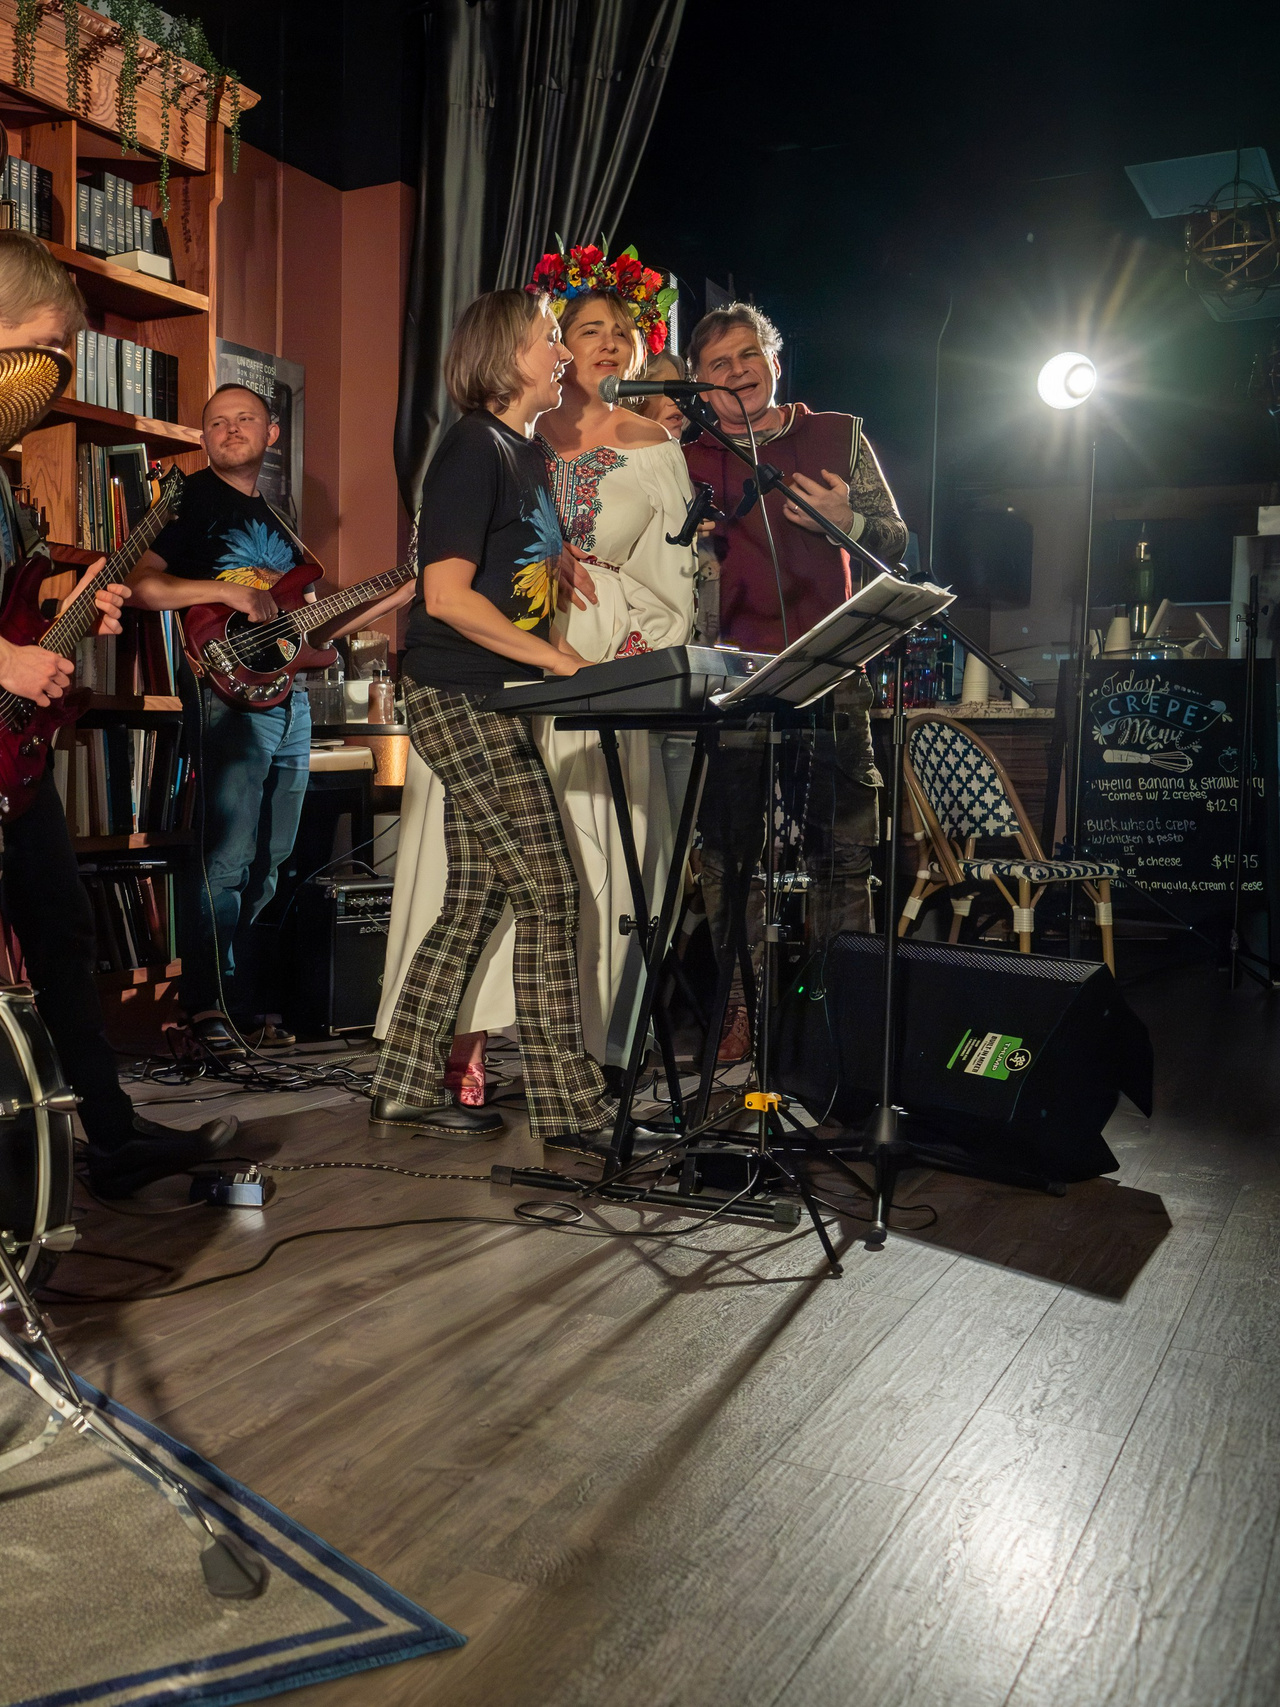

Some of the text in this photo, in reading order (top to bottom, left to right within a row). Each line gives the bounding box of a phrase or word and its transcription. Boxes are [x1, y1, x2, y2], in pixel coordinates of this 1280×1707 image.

[1101, 669, 1170, 706] Today's
[1108, 694, 1199, 726] CREPE
[1117, 717, 1183, 746] Menu
[1190, 778, 1198, 790] &
[1172, 790, 1208, 801] crepes
[1206, 798, 1238, 812] $12.9
[1146, 856, 1183, 868] cheese
[1126, 868, 1136, 876] or
